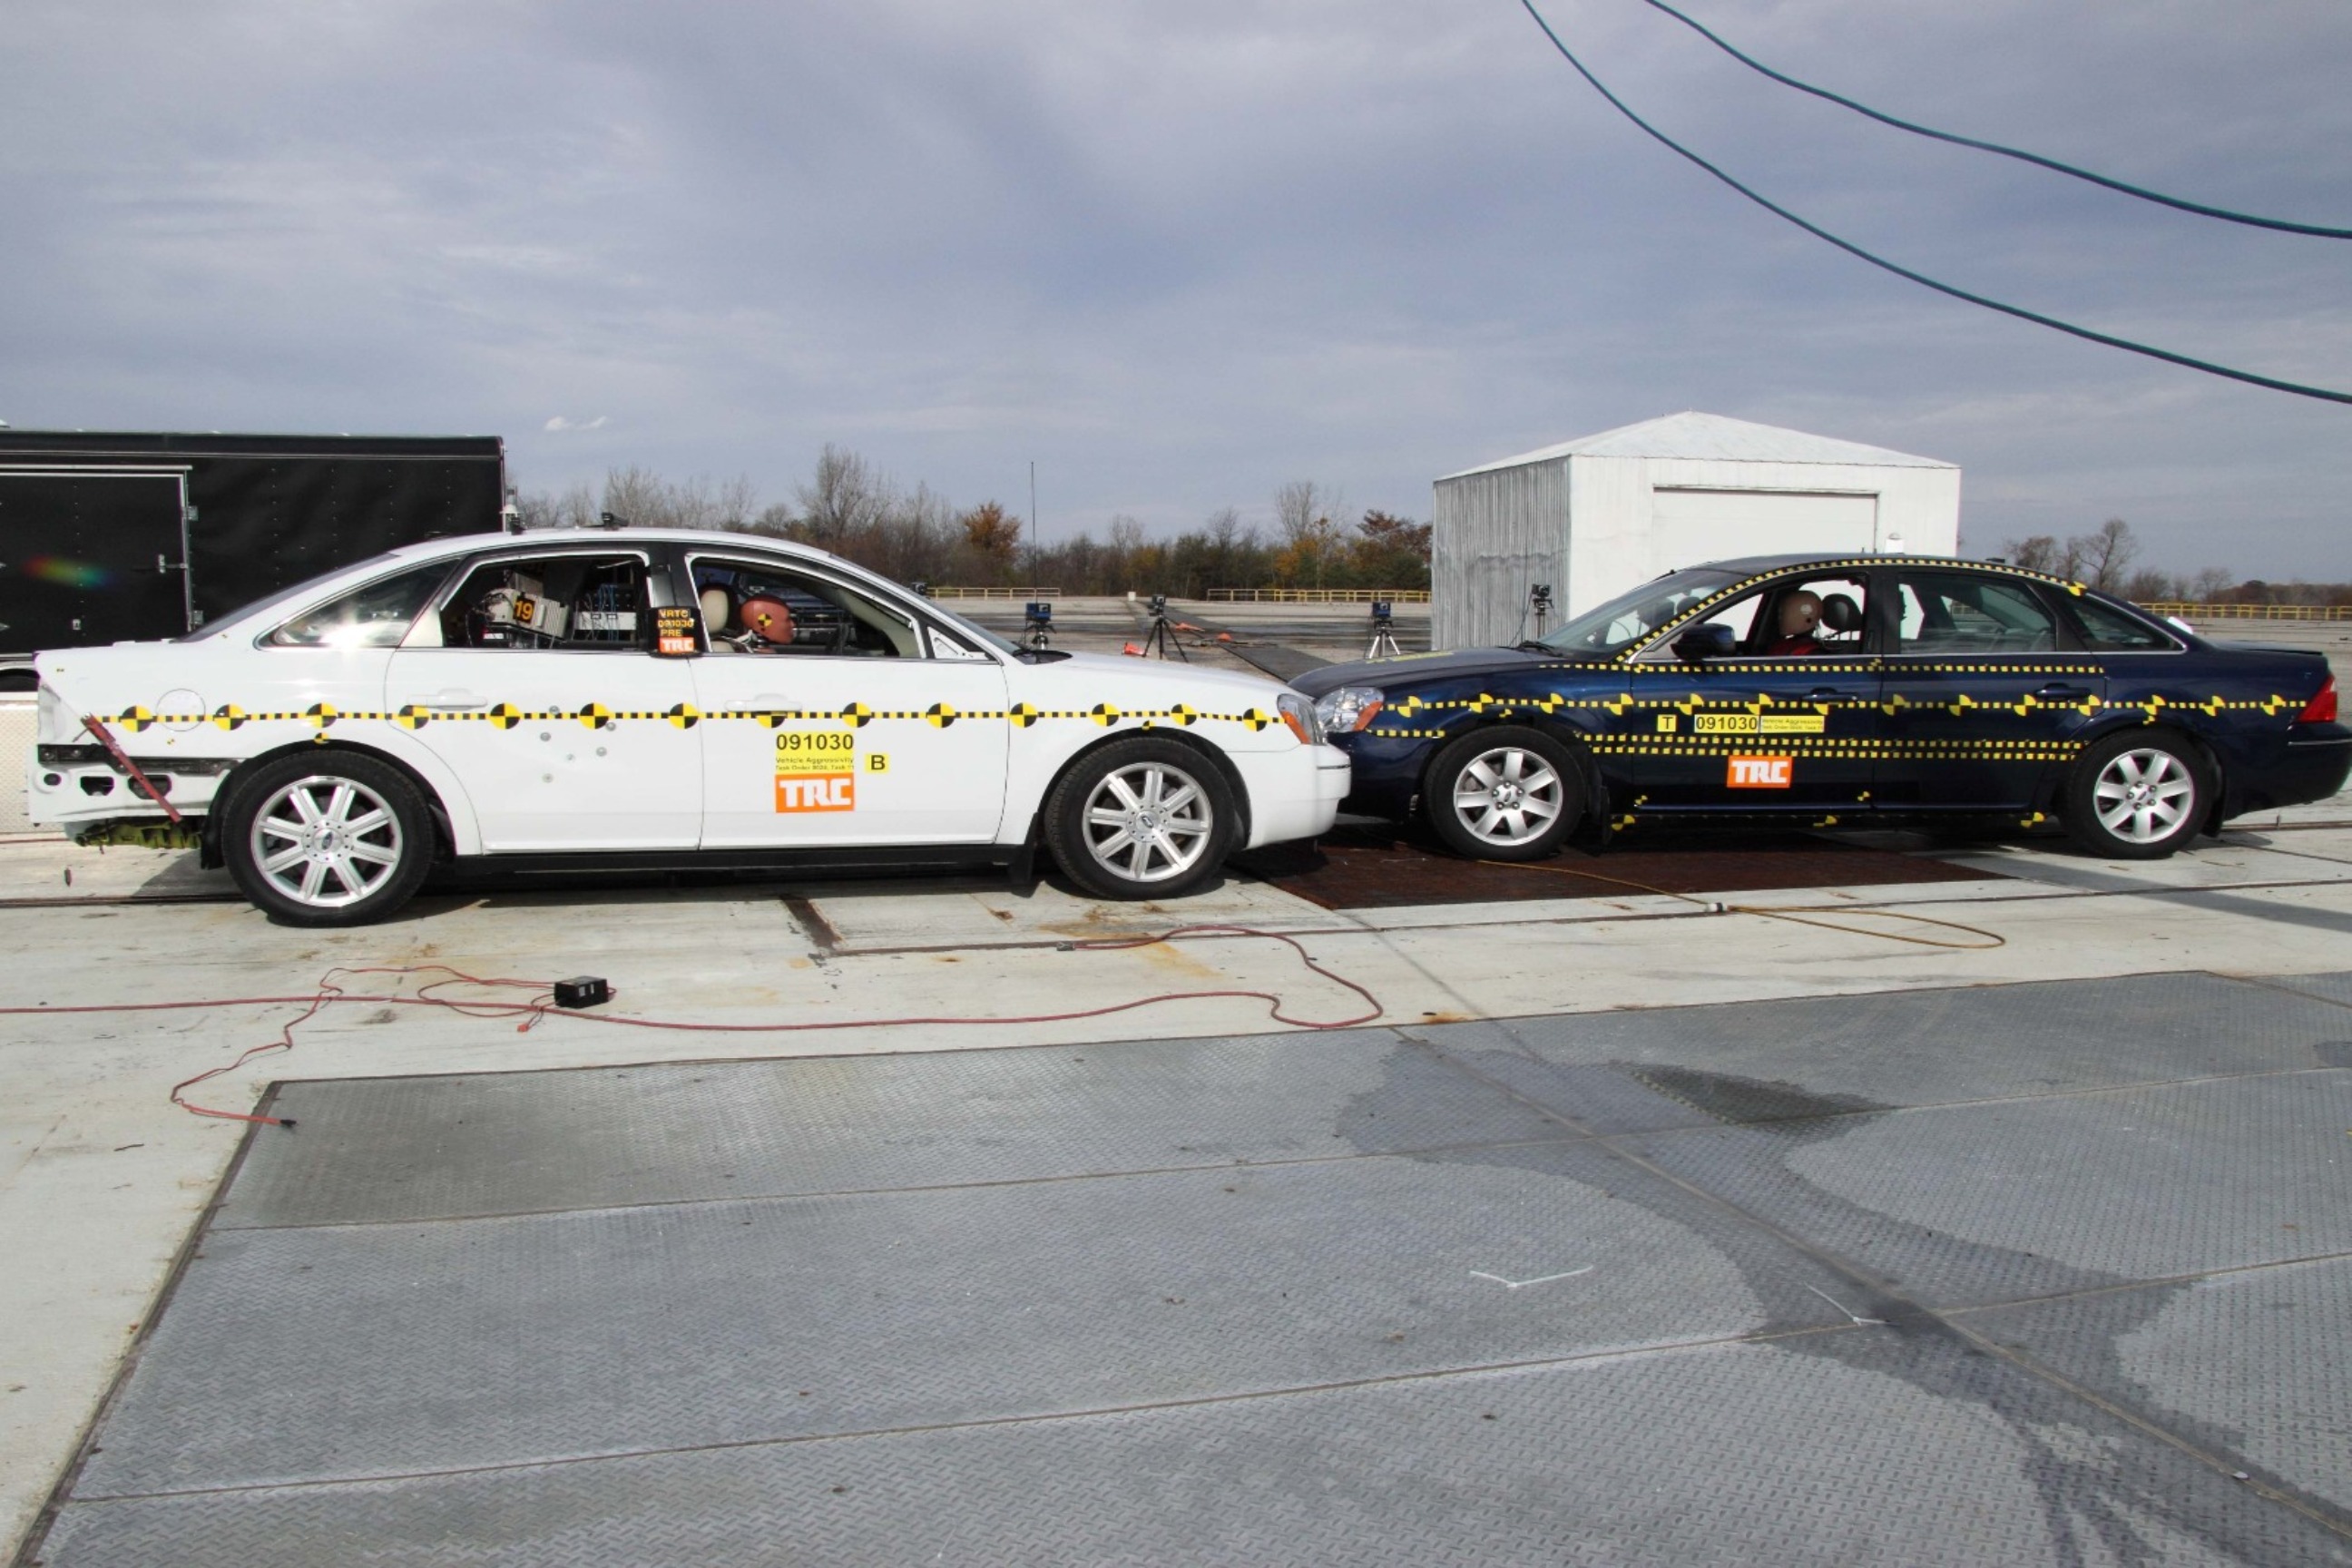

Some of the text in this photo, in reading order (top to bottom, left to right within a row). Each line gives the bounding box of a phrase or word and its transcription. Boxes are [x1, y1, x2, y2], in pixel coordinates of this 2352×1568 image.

[515, 601, 533, 620] 19
[658, 609, 689, 618] VRTC
[658, 619, 695, 628] 091030
[662, 638, 694, 652] TRC
[1661, 716, 1673, 730] T
[1695, 716, 1758, 730] 091030
[776, 733, 854, 750] 091030
[870, 754, 886, 770] B
[1730, 760, 1788, 784] TRC
[779, 778, 852, 808] TRC
